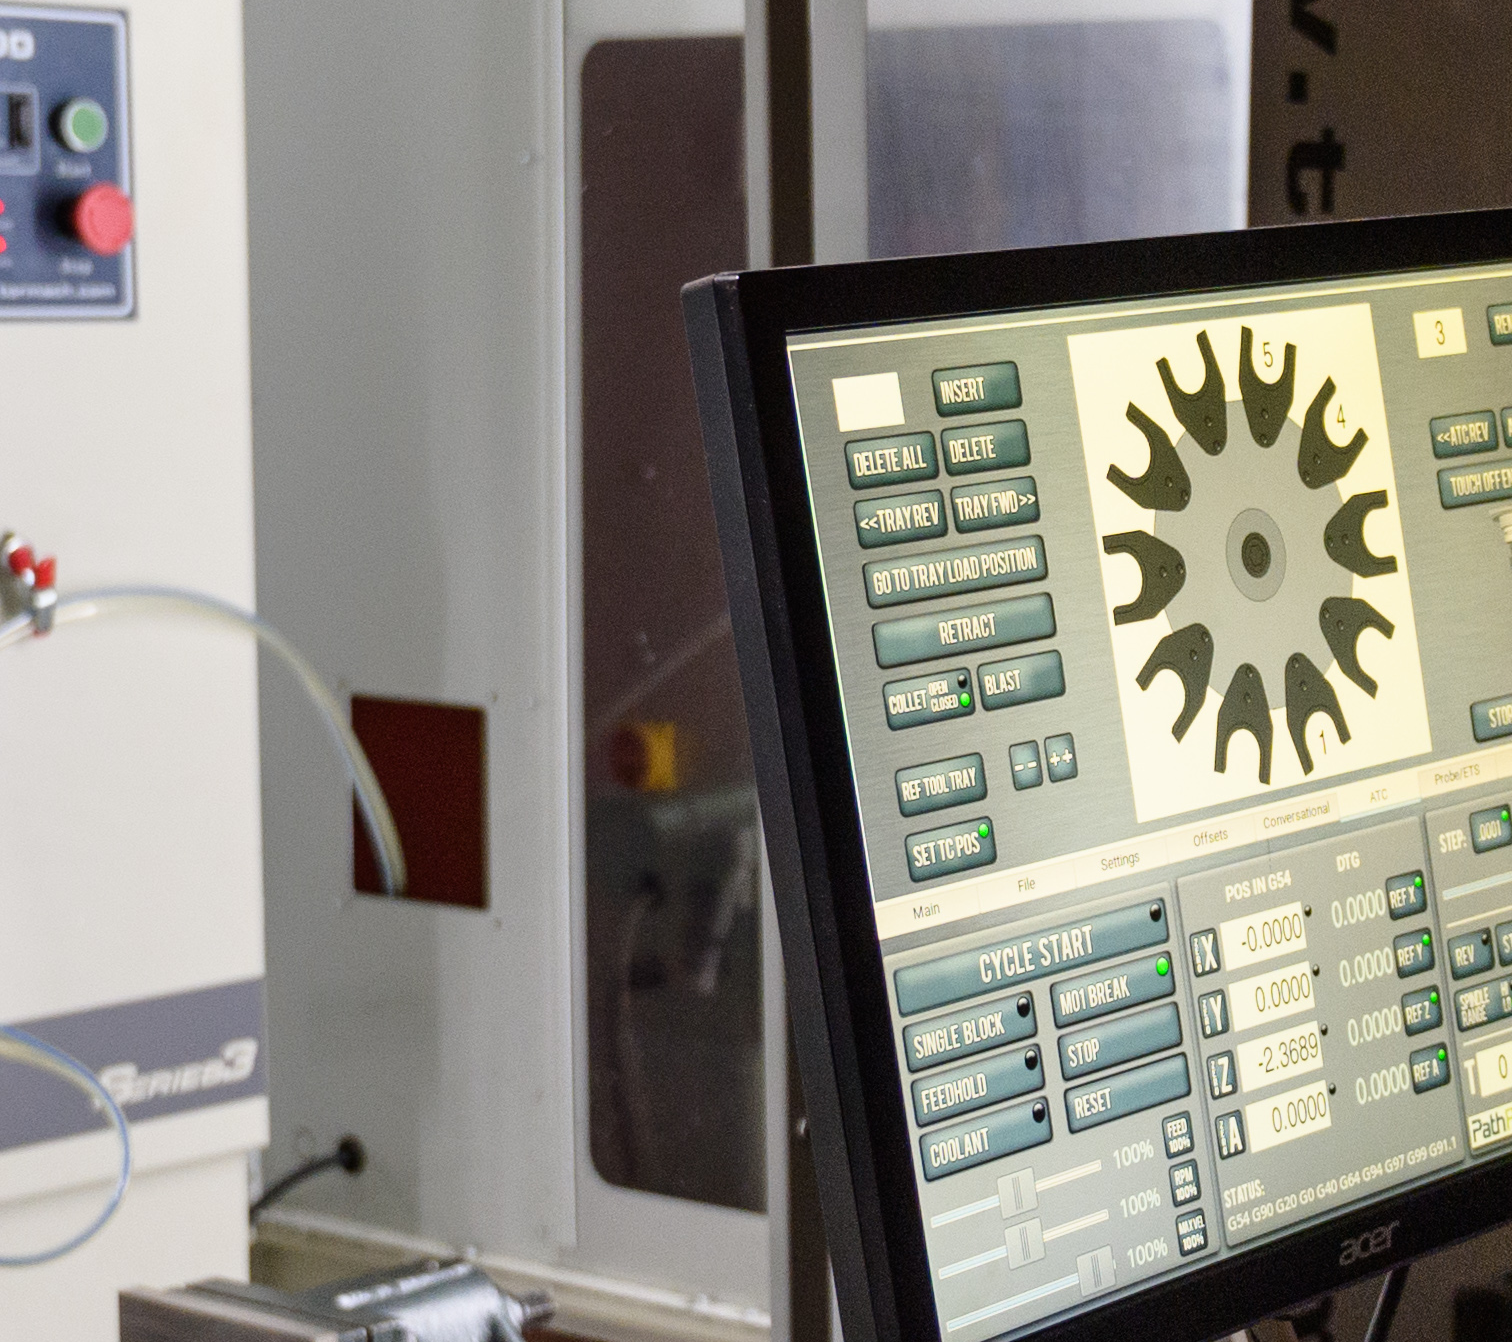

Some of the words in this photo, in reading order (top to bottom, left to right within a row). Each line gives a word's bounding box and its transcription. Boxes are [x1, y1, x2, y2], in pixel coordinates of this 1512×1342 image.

[1434, 319, 1446, 346] 3
[1262, 341, 1274, 368] 5
[939, 377, 986, 405] INSERT
[1336, 404, 1347, 429] 4
[852, 447, 901, 477] DELETE
[902, 444, 928, 470] ALL
[949, 435, 997, 464] DELETE
[1449, 474, 1481, 497] TOUCH
[1481, 471, 1502, 493] OFF
[913, 501, 940, 528] REV
[954, 493, 990, 521] TRAY
[872, 570, 892, 596] GO
[891, 566, 910, 592] TO
[910, 560, 947, 589] TRAY
[947, 556, 980, 584] LOAD
[980, 545, 1038, 579] POSITION
[937, 612, 997, 646] RETRACT
[928, 679, 949, 698] OPEN
[983, 669, 1022, 696] BLAST
[888, 688, 928, 715] COLLET
[930, 693, 960, 713] CLOSED
[1319, 729, 1328, 755] 1
[901, 780, 922, 803] REF
[923, 772, 949, 798] TOOL
[948, 766, 977, 793] TRAY
[912, 902, 941, 920] Main
[1017, 877, 1036, 893] File
[1100, 850, 1141, 872] Settings
[1193, 828, 1229, 848] Offsets
[1262, 800, 1331, 830] Conversational
[1369, 787, 1389, 804] ATC
[1433, 763, 1481, 786] Probe/ETS
[912, 841, 936, 869] SET
[936, 836, 956, 862] TC
[955, 831, 981, 859] POS
[1438, 827, 1467, 854] STEP:
[1225, 882, 1251, 904] POS
[1252, 877, 1267, 897] IN
[1269, 869, 1293, 892] G54
[1336, 850, 1361, 873] DTG
[1201, 932, 1219, 972] X
[1241, 912, 1303, 952] -0.0000
[1330, 888, 1387, 929] 0.0000
[1389, 888, 1408, 911] REF
[1407, 885, 1417, 905] X
[978, 940, 1035, 984] CYCLE
[1038, 924, 1094, 968] START
[1454, 944, 1476, 967] REV
[1088, 975, 1131, 1010] BREAK
[1209, 994, 1224, 1032] Y
[1255, 972, 1311, 1013] 0.0000
[1338, 946, 1395, 988] 0.0000
[1397, 947, 1416, 969] REF
[1414, 942, 1424, 961] Y
[913, 1023, 962, 1060] SINGLE
[961, 1011, 1006, 1047] BLOCK
[1218, 1055, 1234, 1094] Z
[1258, 1031, 1319, 1073] -2.3689
[1347, 1004, 1402, 1047] 0.0000
[1405, 1003, 1424, 1026] REF
[1423, 998, 1433, 1019] Z
[1067, 1038, 1101, 1069] STOP
[1498, 1053, 1508, 1080] 0
[920, 1072, 988, 1115] FEEDHOLD
[1073, 1087, 1112, 1119] RESET
[1229, 1115, 1244, 1153] A
[1271, 1090, 1328, 1134] 0.0000
[1354, 1062, 1410, 1105] 0.0000
[1413, 1061, 1431, 1084] REF
[1431, 1058, 1441, 1077] A
[929, 1126, 990, 1169] COOLANT
[1112, 1139, 1155, 1170] 100%
[1166, 1117, 1188, 1138] FEED
[1168, 1136, 1191, 1155] 100%
[1119, 1187, 1161, 1219] 100%
[1173, 1165, 1194, 1187] RPM
[1175, 1184, 1198, 1203] 100%
[1223, 1178, 1266, 1210] STATUS:
[1227, 1210, 1249, 1232] G54
[1251, 1203, 1275, 1226] G90
[1275, 1195, 1298, 1218] G20
[1299, 1189, 1316, 1210] G0
[1316, 1181, 1339, 1204] G40
[1339, 1174, 1361, 1197] G64
[1361, 1165, 1384, 1188] G94
[1384, 1157, 1406, 1180] G97
[1407, 1148, 1430, 1171] G99
[1429, 1135, 1457, 1162] G91.1
[1127, 1238, 1169, 1269] 100%
[1182, 1233, 1205, 1252] 100%
[1339, 1219, 1400, 1268] acer
